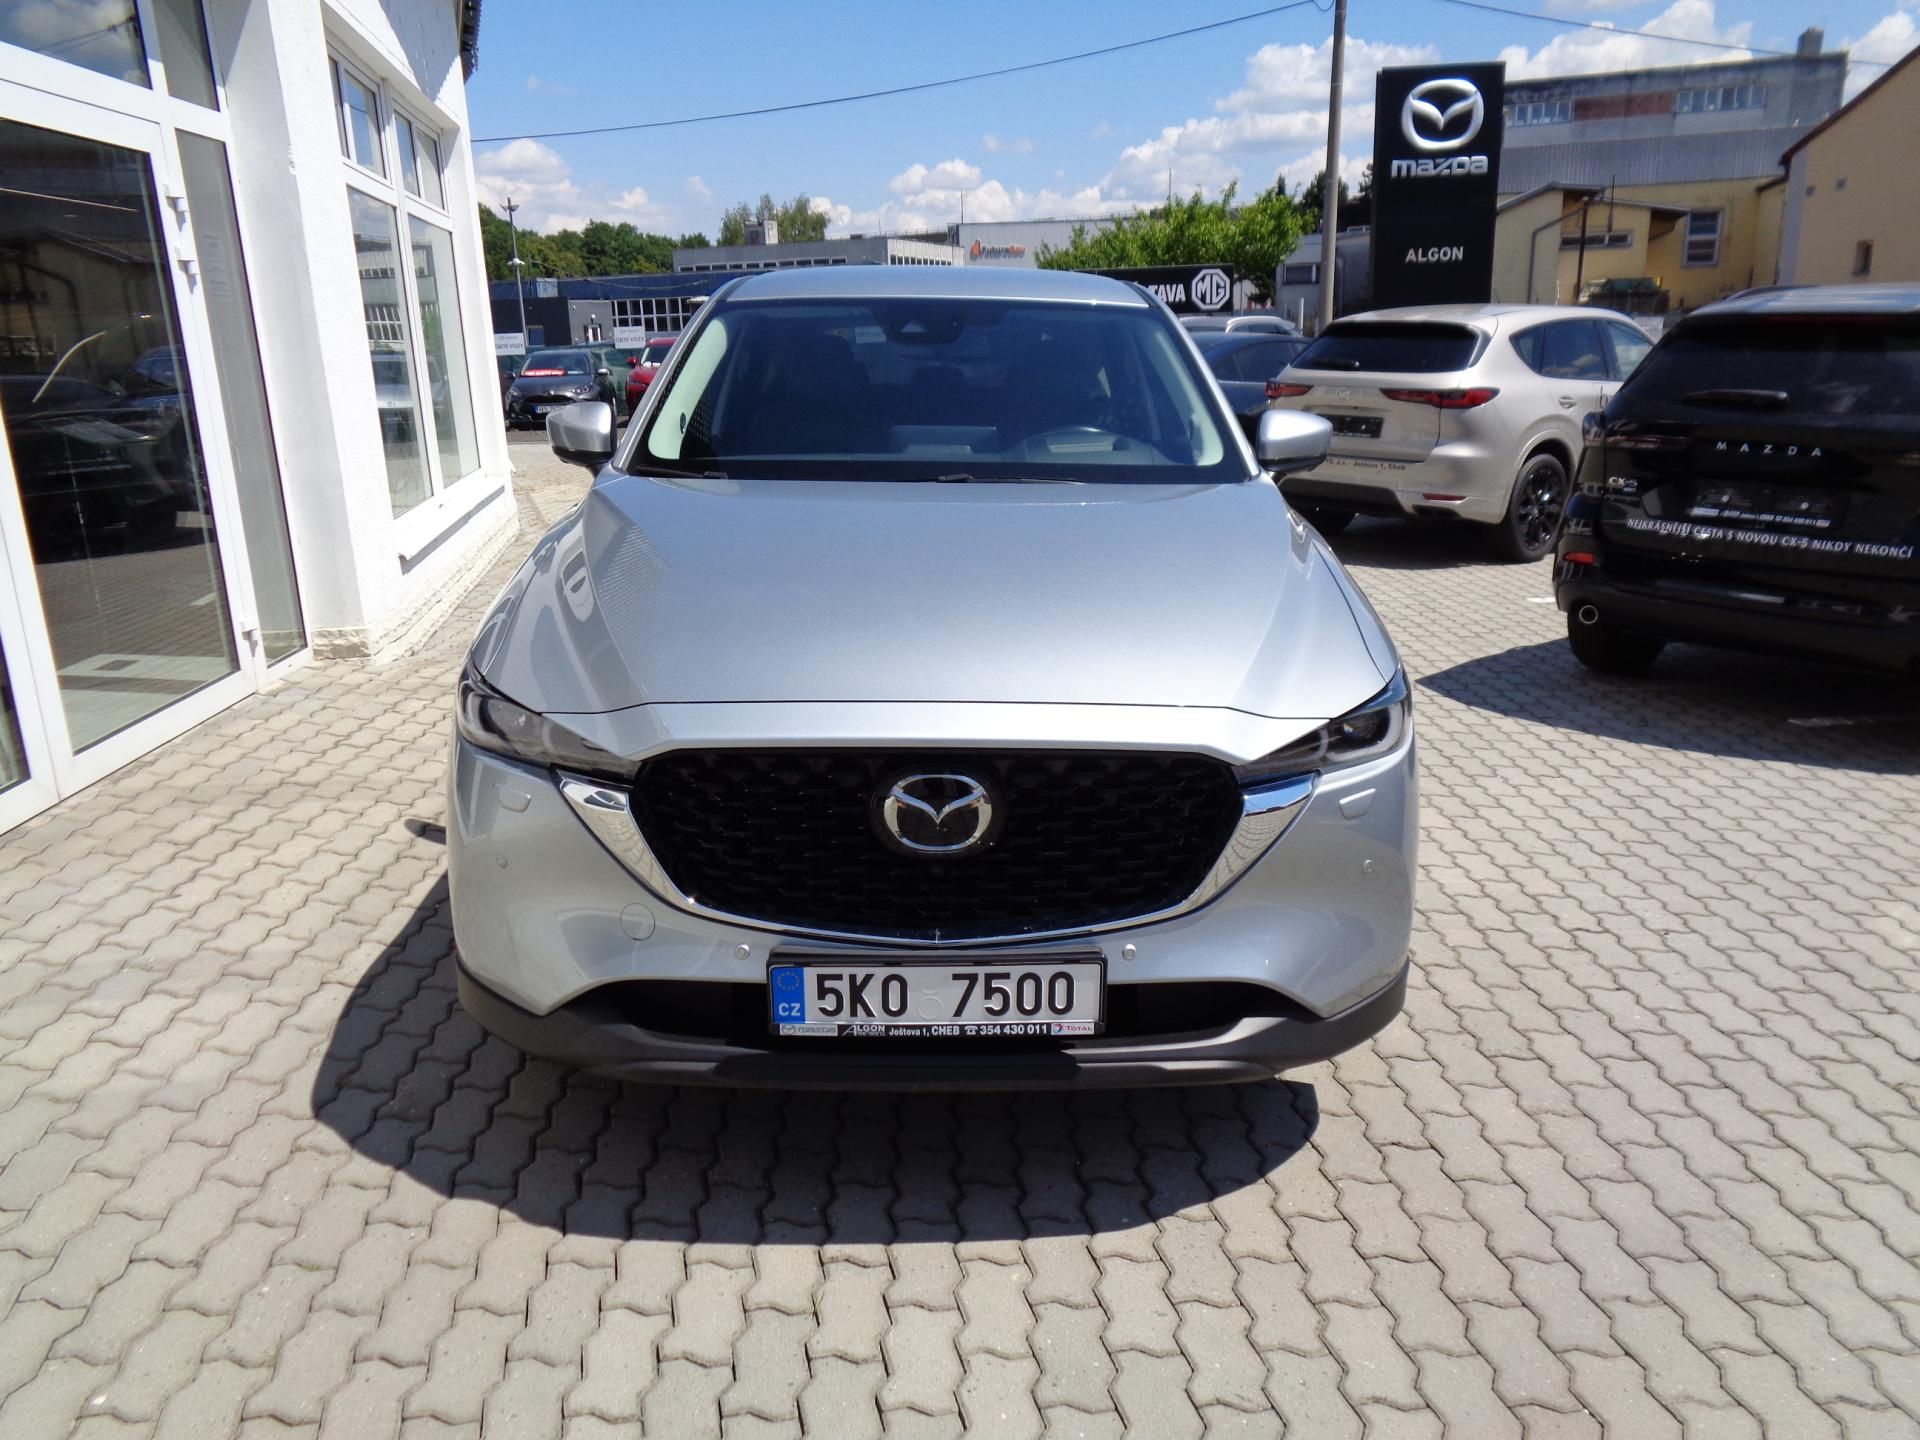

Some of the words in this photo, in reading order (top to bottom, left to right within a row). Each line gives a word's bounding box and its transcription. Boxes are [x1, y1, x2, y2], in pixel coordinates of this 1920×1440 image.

[1405, 246, 1464, 264] ALGON
[1195, 272, 1227, 306] MG
[1716, 441, 1822, 457] MAZDA
[1609, 476, 1638, 488] CX-5
[1693, 525, 1724, 538] CESTA
[1727, 530, 1736, 541] S
[1736, 532, 1778, 546] NOVOU
[1782, 536, 1808, 549] CX-5
[1812, 539, 1852, 552] NIKDY
[951, 971, 1075, 1018] 7500
[778, 1003, 800, 1017] CZ
[842, 1024, 886, 1037] ALGON
[931, 1025, 960, 1036] CHEB
[980, 1024, 1001, 1036] 354
[1003, 1024, 1025, 1035] 430
[1027, 1024, 1047, 1035] 011
